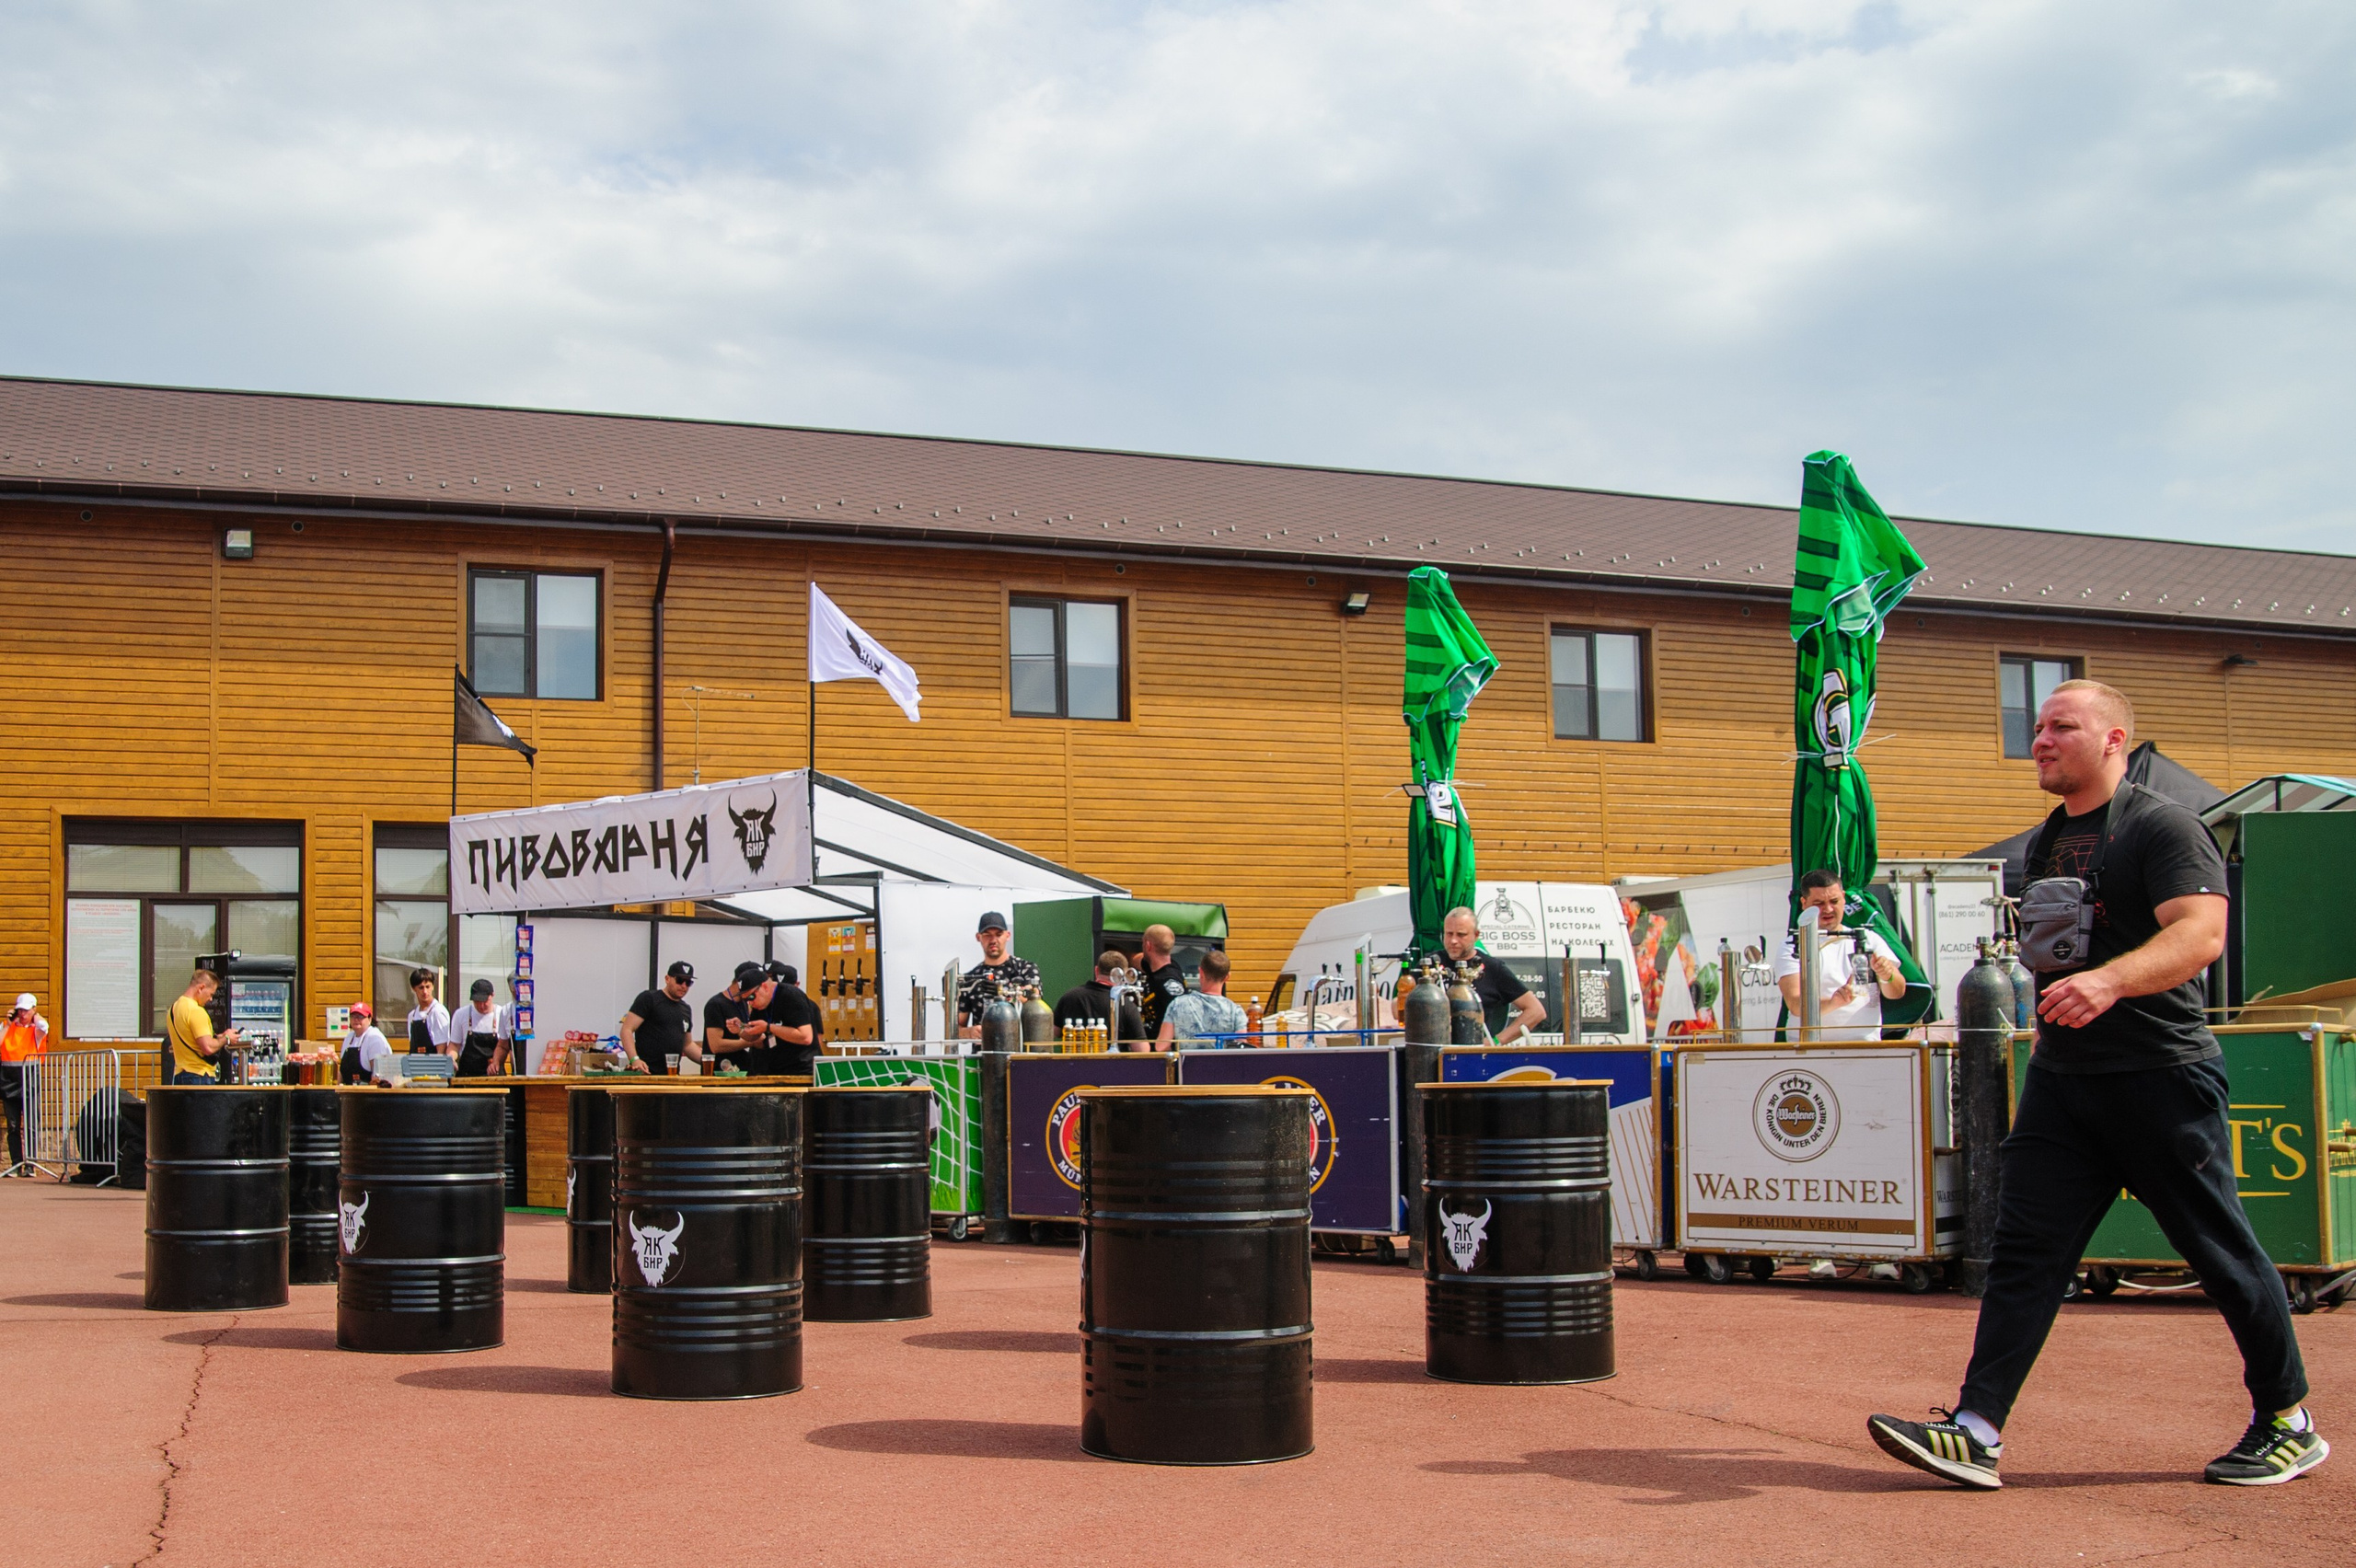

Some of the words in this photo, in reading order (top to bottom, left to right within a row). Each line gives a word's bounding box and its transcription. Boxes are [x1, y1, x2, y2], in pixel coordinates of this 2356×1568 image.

[742, 814, 765, 842] ЯК
[468, 814, 709, 896] ПИВОВАРНЯ
[1547, 905, 1596, 914] БАРБЕКЮ
[1549, 922, 1601, 930] РЕСТОРАН
[1478, 931, 1498, 940] BIG
[1502, 931, 1536, 940] BOSS
[1551, 938, 1565, 946] НА
[1568, 938, 1615, 947] КОЛЕСАХ
[1496, 942, 1518, 951] BBQ
[1767, 1093, 1780, 1108] DIE
[1812, 1093, 1827, 1124] BIEREN
[1809, 1124, 1825, 1143] DEN
[1783, 1137, 1811, 1148] UNTER
[1692, 1172, 1903, 1205] WARSTEINER
[1451, 1220, 1474, 1241] ЯК
[1738, 1216, 1803, 1229] PREMIUM
[1808, 1217, 1859, 1231] VERUM
[641, 1234, 665, 1256] ЯК
